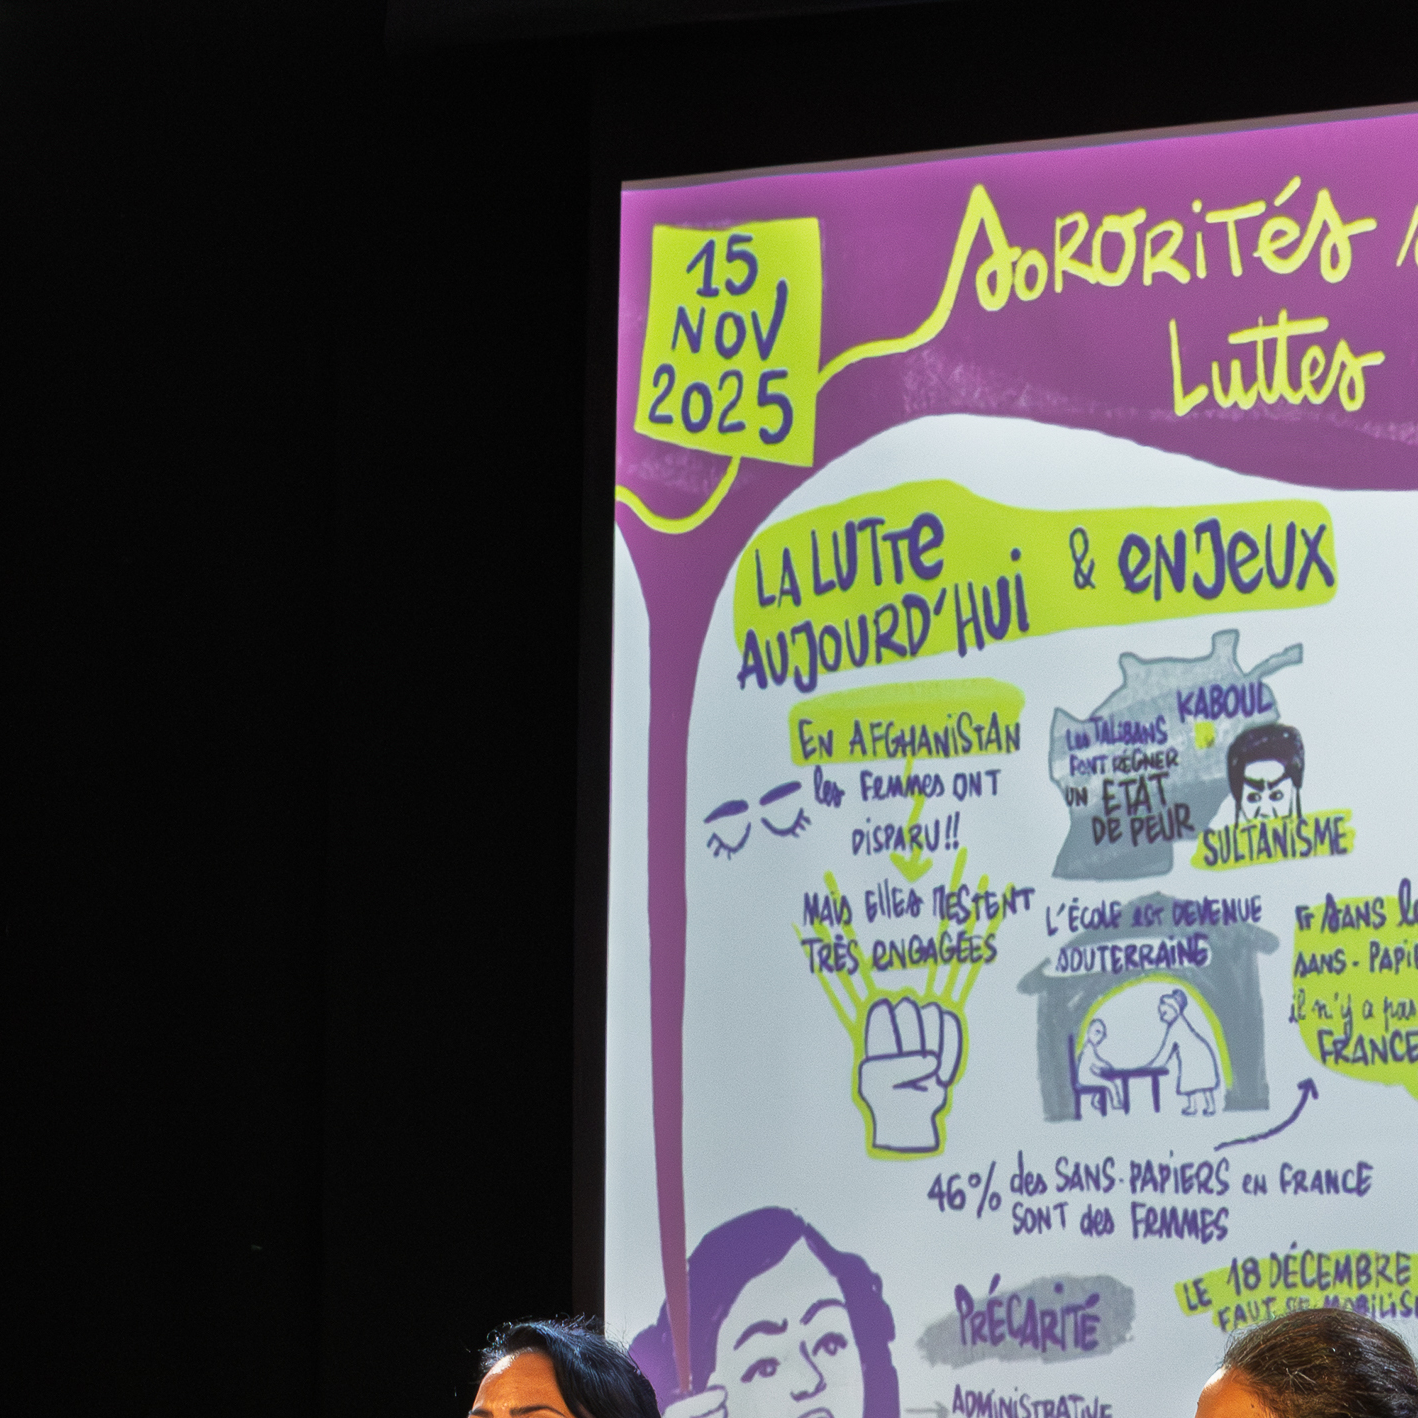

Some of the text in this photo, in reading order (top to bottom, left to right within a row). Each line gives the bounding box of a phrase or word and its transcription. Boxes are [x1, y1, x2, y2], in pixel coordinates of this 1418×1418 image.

[685, 233, 759, 298] 15
[671, 279, 789, 360] NOV
[1170, 310, 1385, 416] Luttes
[648, 363, 793, 444] 2025
[754, 541, 801, 608] LA
[1177, 682, 1273, 722] KABOUL
[953, 769, 1001, 801] ONT
[1065, 786, 1088, 806] UN
[1130, 802, 1195, 847] PEUR
[1363, 1000, 1374, 1020] a
[1384, 996, 1416, 1032] pas
[927, 1161, 1002, 1219] 46%
[1009, 1150, 1048, 1195] des
[1280, 1162, 1374, 1197] FRANCE
[1012, 1202, 1069, 1234] SONT
[1080, 1203, 1115, 1237] des
[1184, 1278, 1212, 1311] LE
[1227, 1256, 1261, 1297] 18
[1270, 1240, 1411, 1291] DÉCEMBRE
[1218, 1296, 1277, 1333] FAUT
